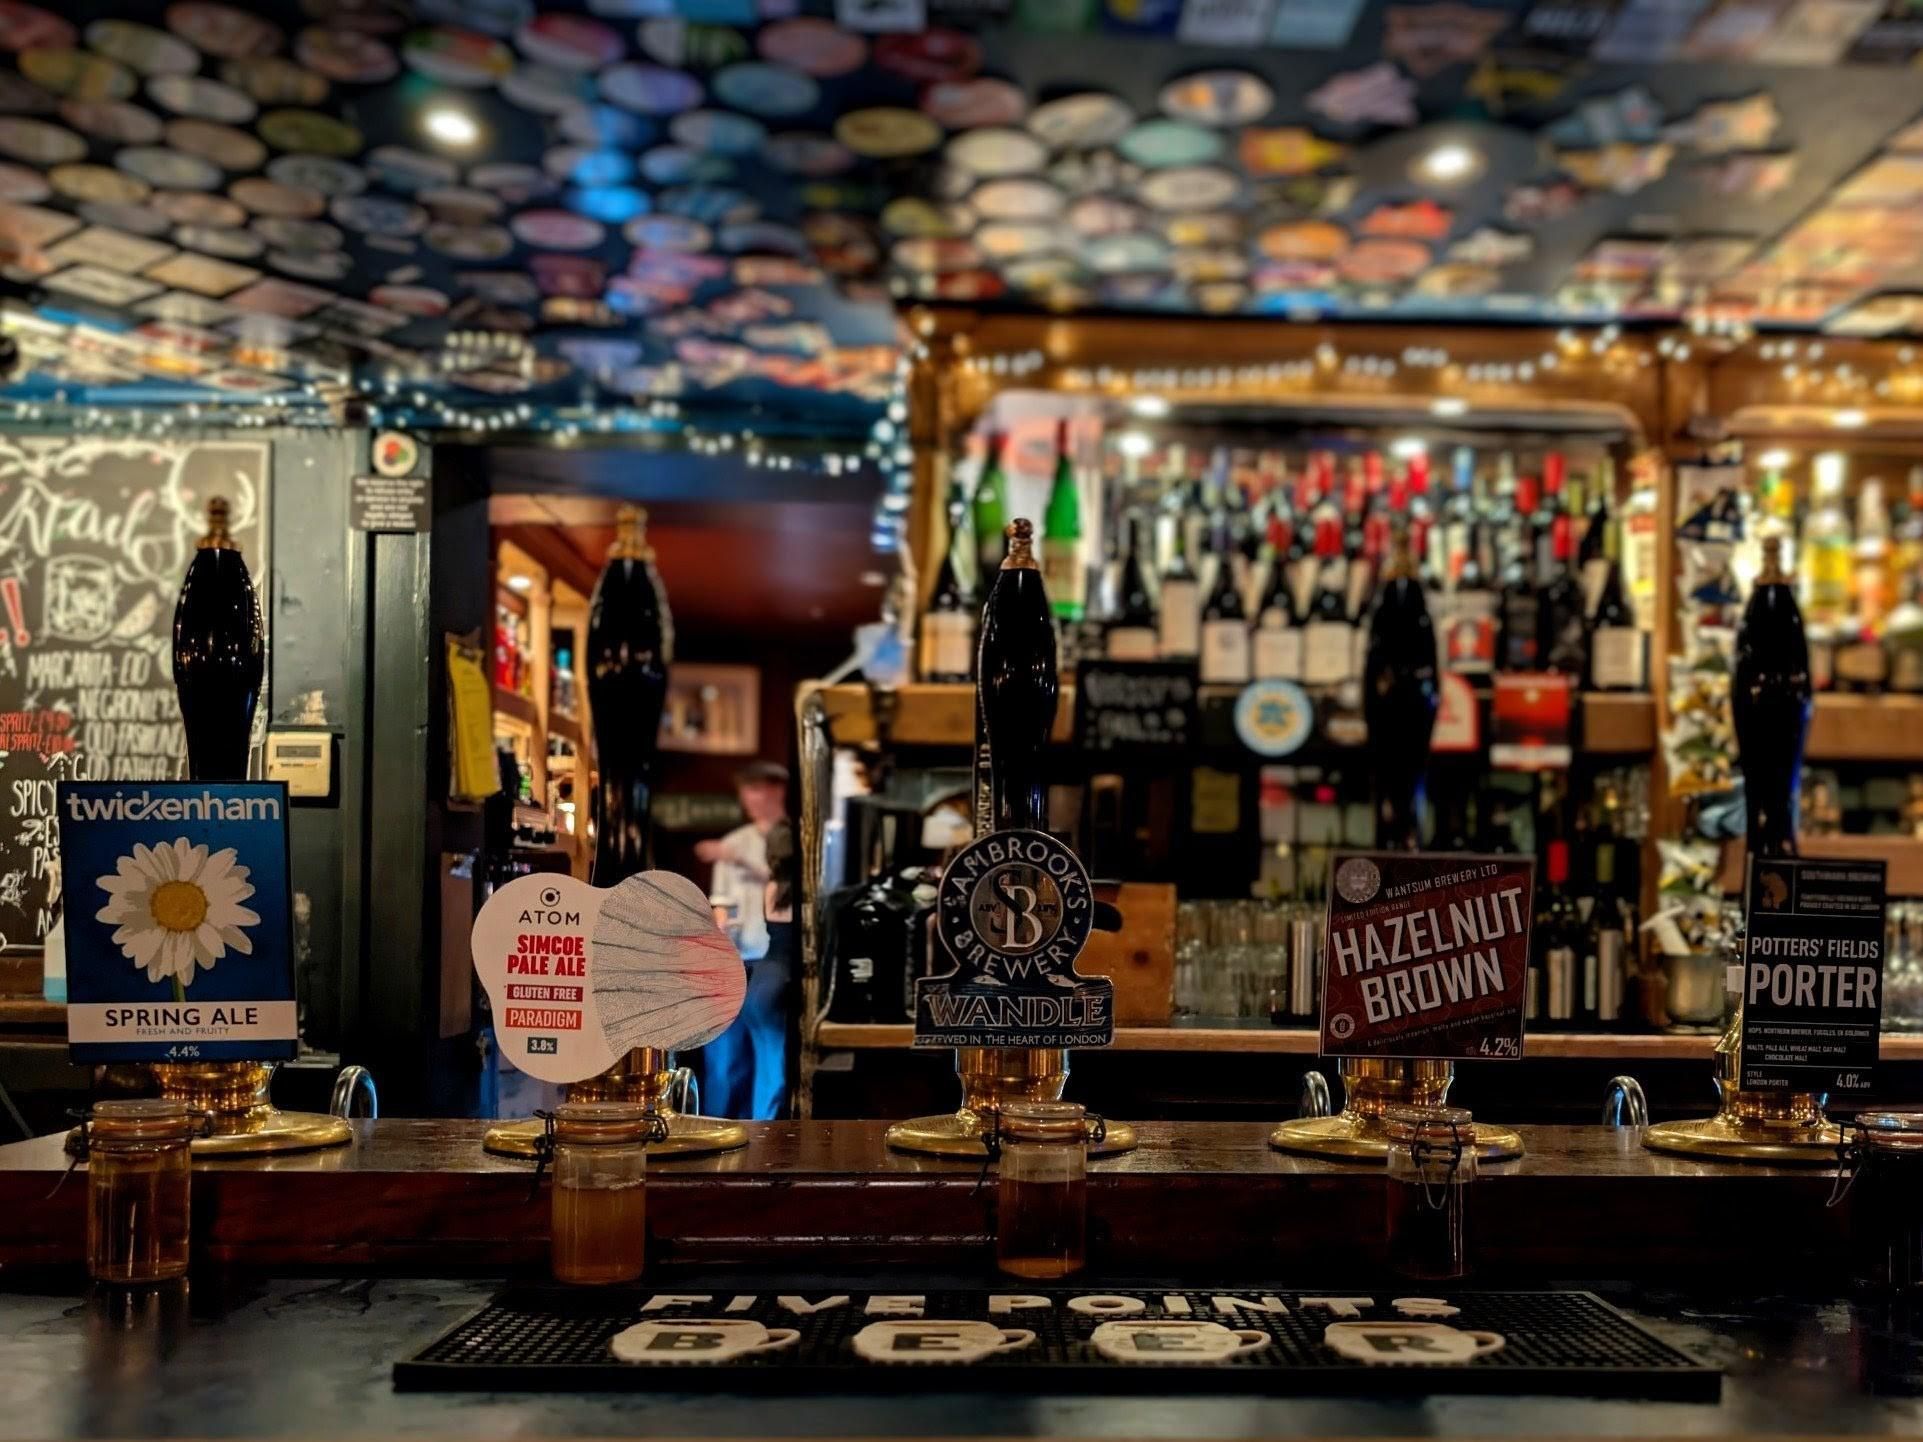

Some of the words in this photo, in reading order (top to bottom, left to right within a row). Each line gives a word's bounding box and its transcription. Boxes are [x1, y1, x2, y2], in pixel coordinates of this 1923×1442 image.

[66, 790, 280, 822] twickenham
[1385, 878, 1432, 899] WANTSUM
[1434, 867, 1477, 888] BREWERY
[1480, 864, 1498, 877] LTD
[518, 910, 580, 926] ATOM
[1332, 886, 1524, 977] HAZELNUT
[517, 934, 584, 956] SIMCOE
[953, 926, 1078, 981] BREWERY
[1751, 936, 1825, 957] POTTERS'
[1827, 939, 1879, 959] FIELDS
[507, 955, 549, 976] PALE
[554, 957, 586, 977] ALE
[512, 986, 550, 1000] GLUTEN
[553, 987, 577, 1000] FREE
[1360, 947, 1505, 1025] BROWN
[1749, 962, 1877, 1009] PORTER
[106, 1008, 201, 1027] SPRING
[211, 1007, 258, 1026] ALE
[510, 1010, 577, 1028] PARADIGM
[922, 994, 1107, 1028] WANDLE
[136, 1027, 167, 1036] FRESH
[169, 1027, 192, 1036] AND
[195, 1026, 230, 1036] FRUITY
[970, 1034, 982, 1044] IN
[985, 1034, 1005, 1045] THE
[1008, 1034, 1041, 1045] HEART
[1043, 1034, 1057, 1045] OF
[1060, 1034, 1107, 1045] LONDON
[168, 1046, 200, 1058] 4.4%
[531, 1039, 555, 1052] 3.8%
[1480, 1037, 1519, 1057] 4.2%
[1836, 1073, 1860, 1088] 4.0%
[640, 1295, 926, 1317] FIVE
[988, 1295, 1461, 1318] POINTS
